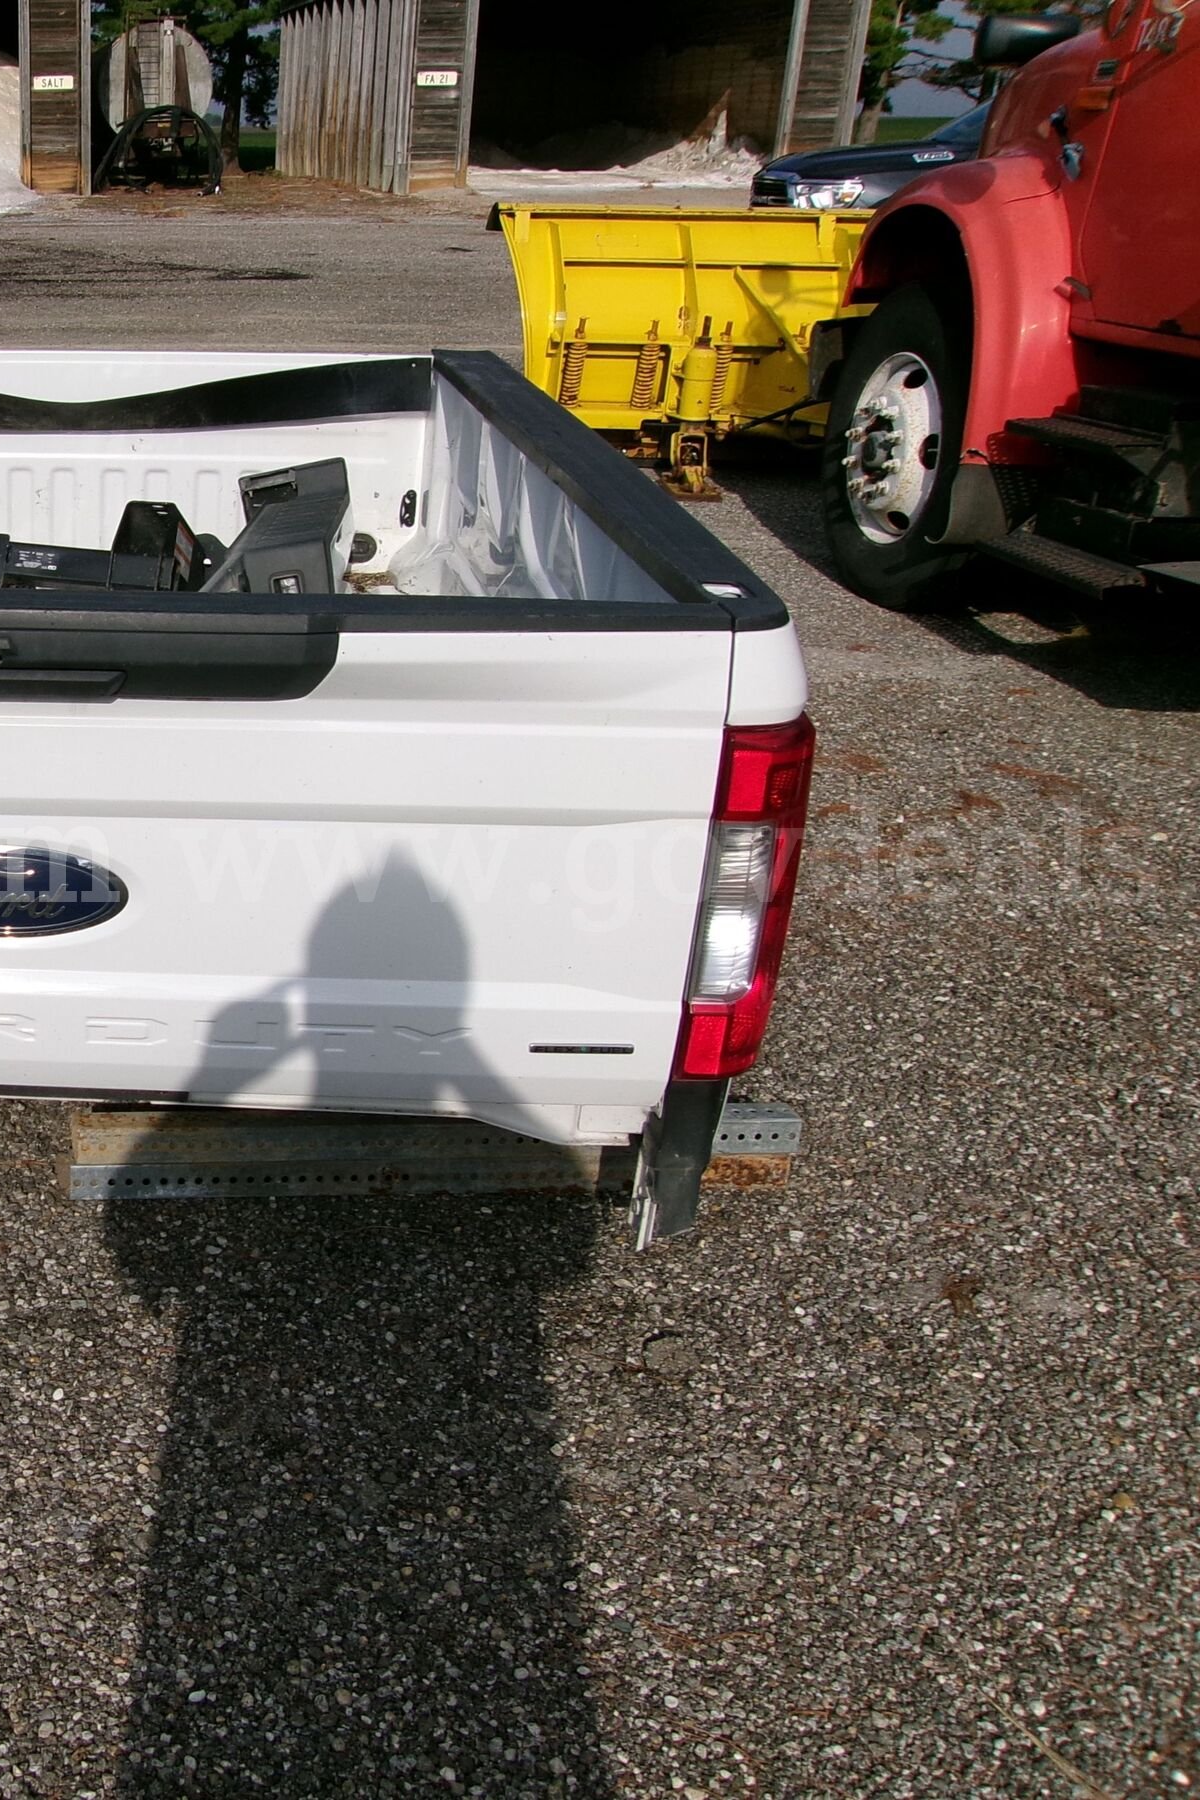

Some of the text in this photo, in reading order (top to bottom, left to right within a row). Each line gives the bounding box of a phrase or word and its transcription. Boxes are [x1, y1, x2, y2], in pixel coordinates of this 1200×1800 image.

[41, 78, 64, 88] SALT
[425, 74, 449, 85] FA 21
[85, 1016, 473, 1056] DUTY
